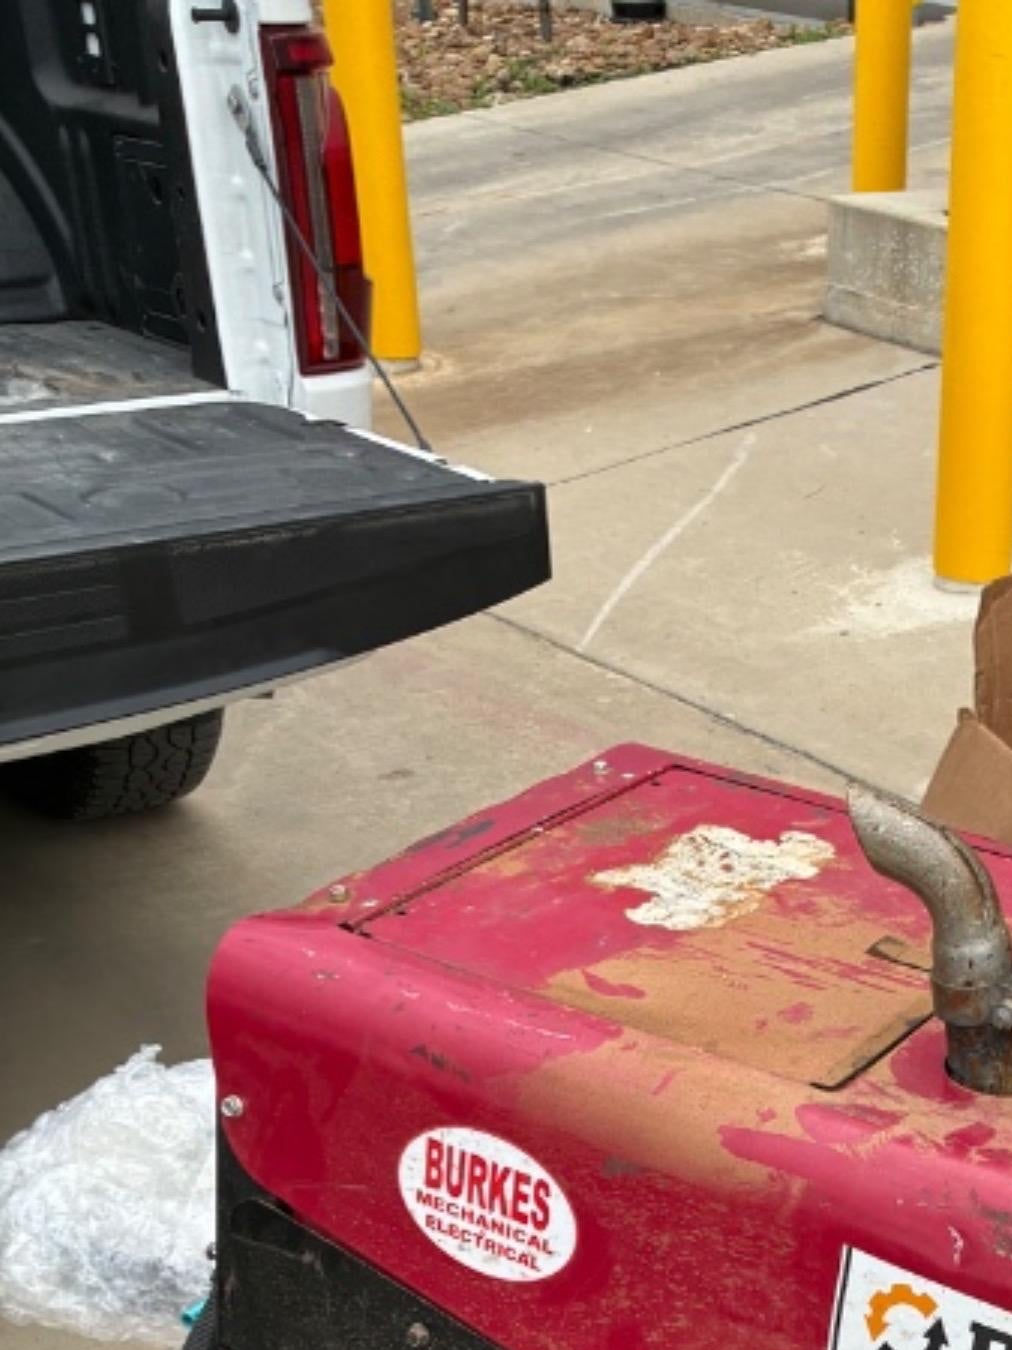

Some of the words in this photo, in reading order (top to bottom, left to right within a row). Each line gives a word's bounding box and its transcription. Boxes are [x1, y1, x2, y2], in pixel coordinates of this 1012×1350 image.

[425, 1137, 552, 1232] BURKES
[415, 1187, 554, 1255] MECHANICAL
[425, 1214, 542, 1273] ELECTRICAL
